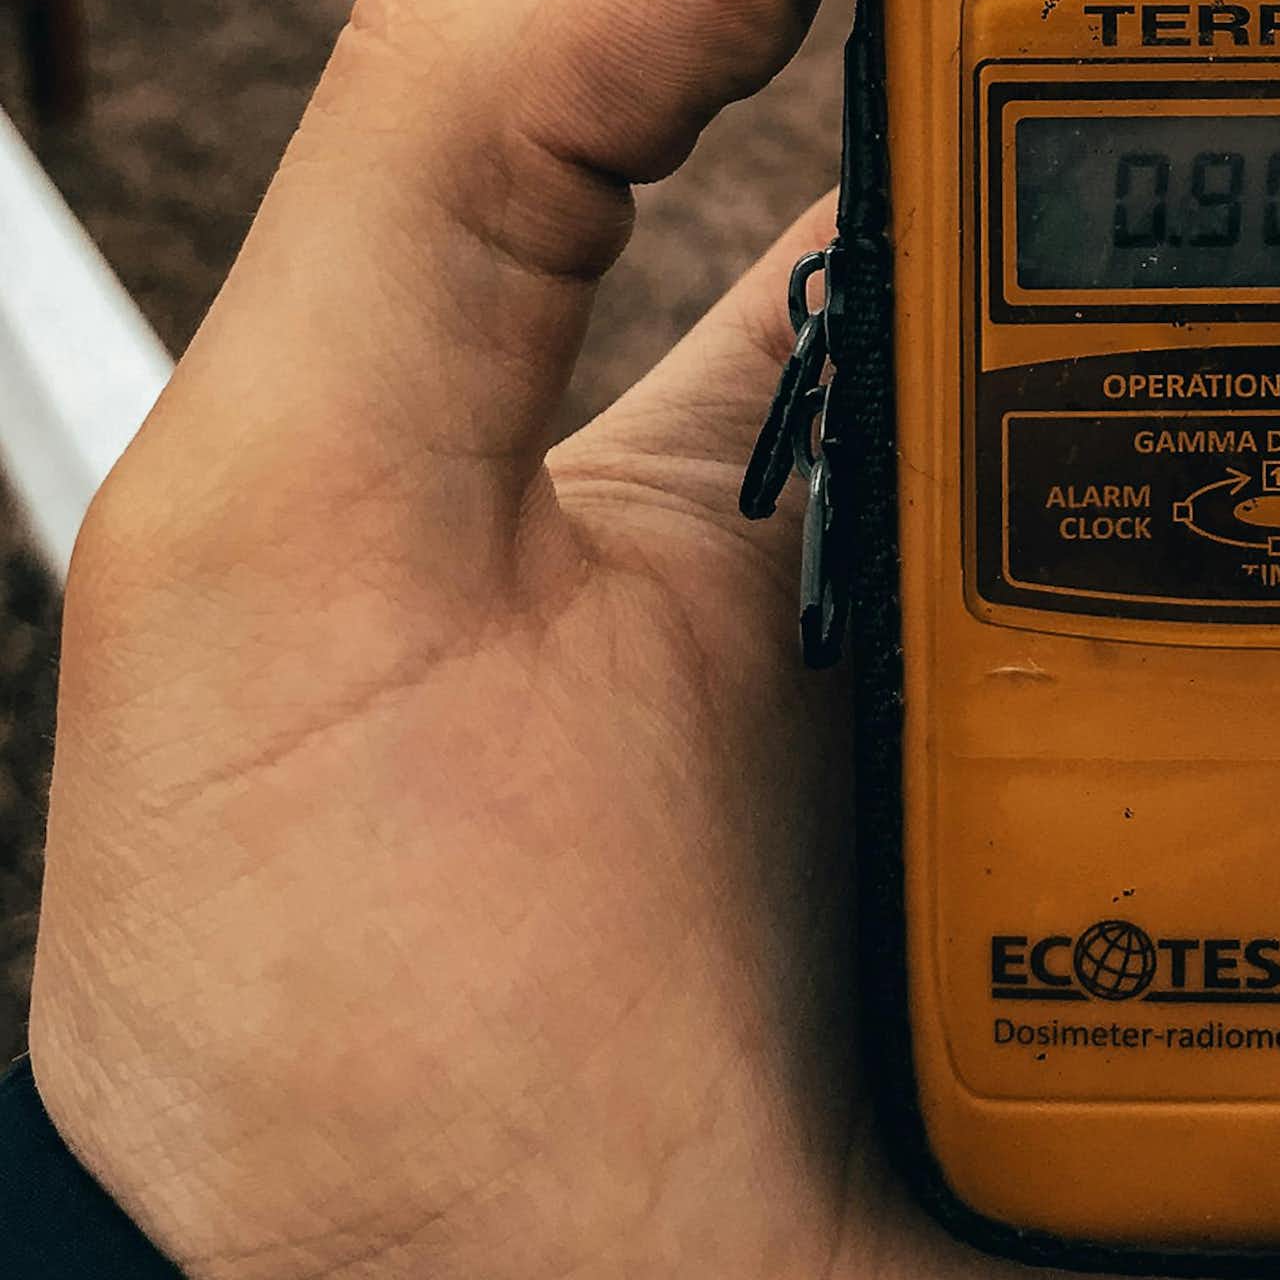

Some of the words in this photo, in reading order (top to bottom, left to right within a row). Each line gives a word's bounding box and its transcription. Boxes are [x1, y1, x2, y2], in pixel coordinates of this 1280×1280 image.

[1133, 431, 1257, 453] GAMMA
[1045, 486, 1152, 509] ALARM
[1059, 517, 1153, 540] CLOCK
